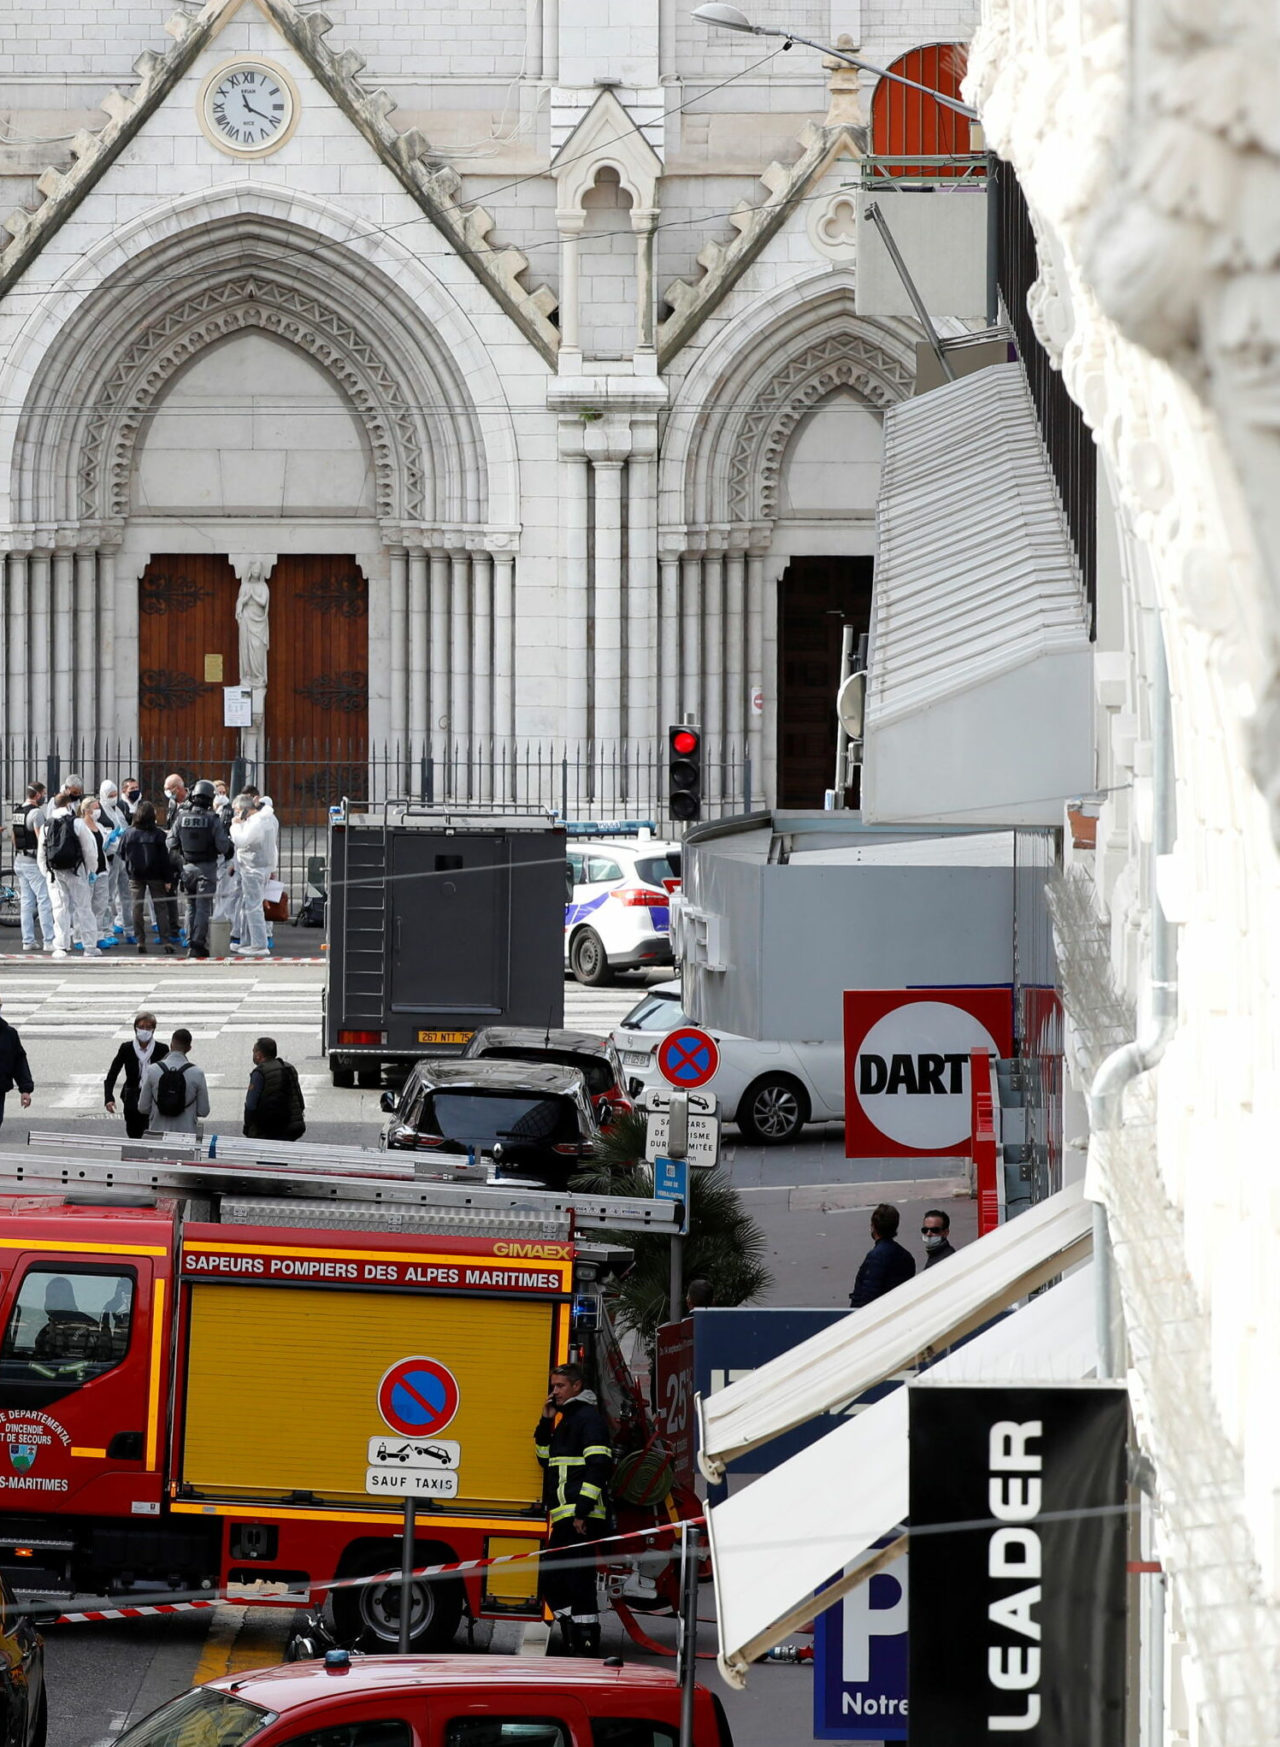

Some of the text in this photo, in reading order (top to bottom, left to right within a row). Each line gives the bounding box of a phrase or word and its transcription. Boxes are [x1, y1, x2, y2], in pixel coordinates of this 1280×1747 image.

[183, 817, 208, 827] BRI
[859, 1053, 996, 1095] DART
[654, 1129, 665, 1137] DE
[650, 1140, 713, 1151] DUR MITÉE
[493, 1242, 571, 1260] GIMAEX
[185, 1254, 559, 1288] SAPEURS POMPIERS DES ALPES MARITIMES
[5, 1423, 44, 1435] D'INCENDIE
[8, 1409, 72, 1447] DEPARTEMENTAL
[6, 1433, 16, 1442] DE
[18, 1434, 52, 1445] SECOURS
[371, 1475, 453, 1490] SAUF TAXIS
[988, 1420, 1042, 1731] LEADER
[842, 1691, 909, 1716] Notre
